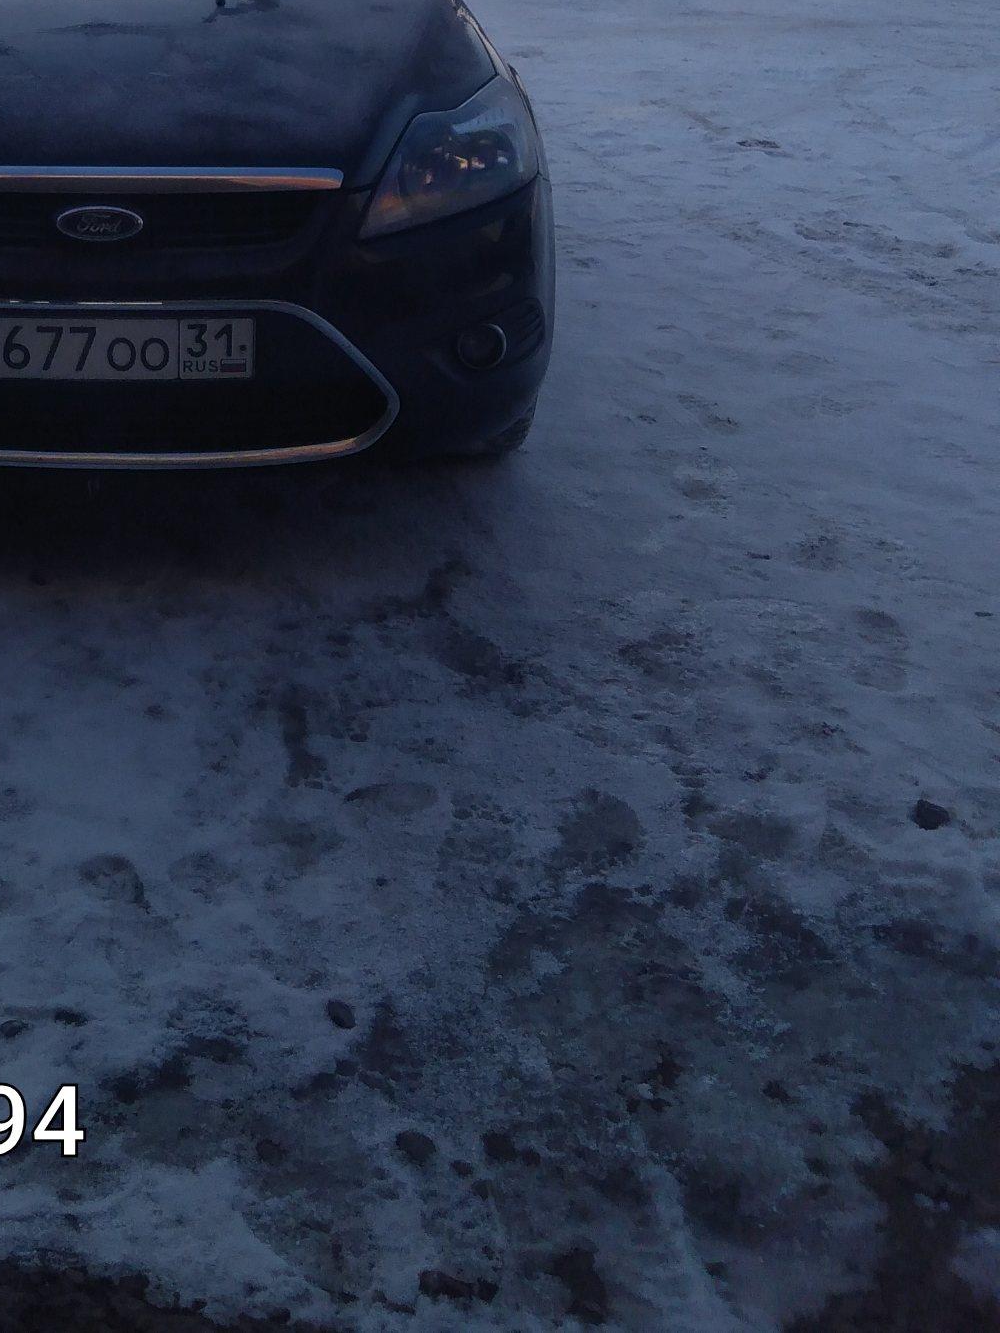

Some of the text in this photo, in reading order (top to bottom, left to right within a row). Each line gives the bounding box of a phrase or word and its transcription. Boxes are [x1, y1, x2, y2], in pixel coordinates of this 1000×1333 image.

[77, 214, 122, 233] Ford
[186, 323, 233, 357] 31
[182, 360, 218, 373] RUS
